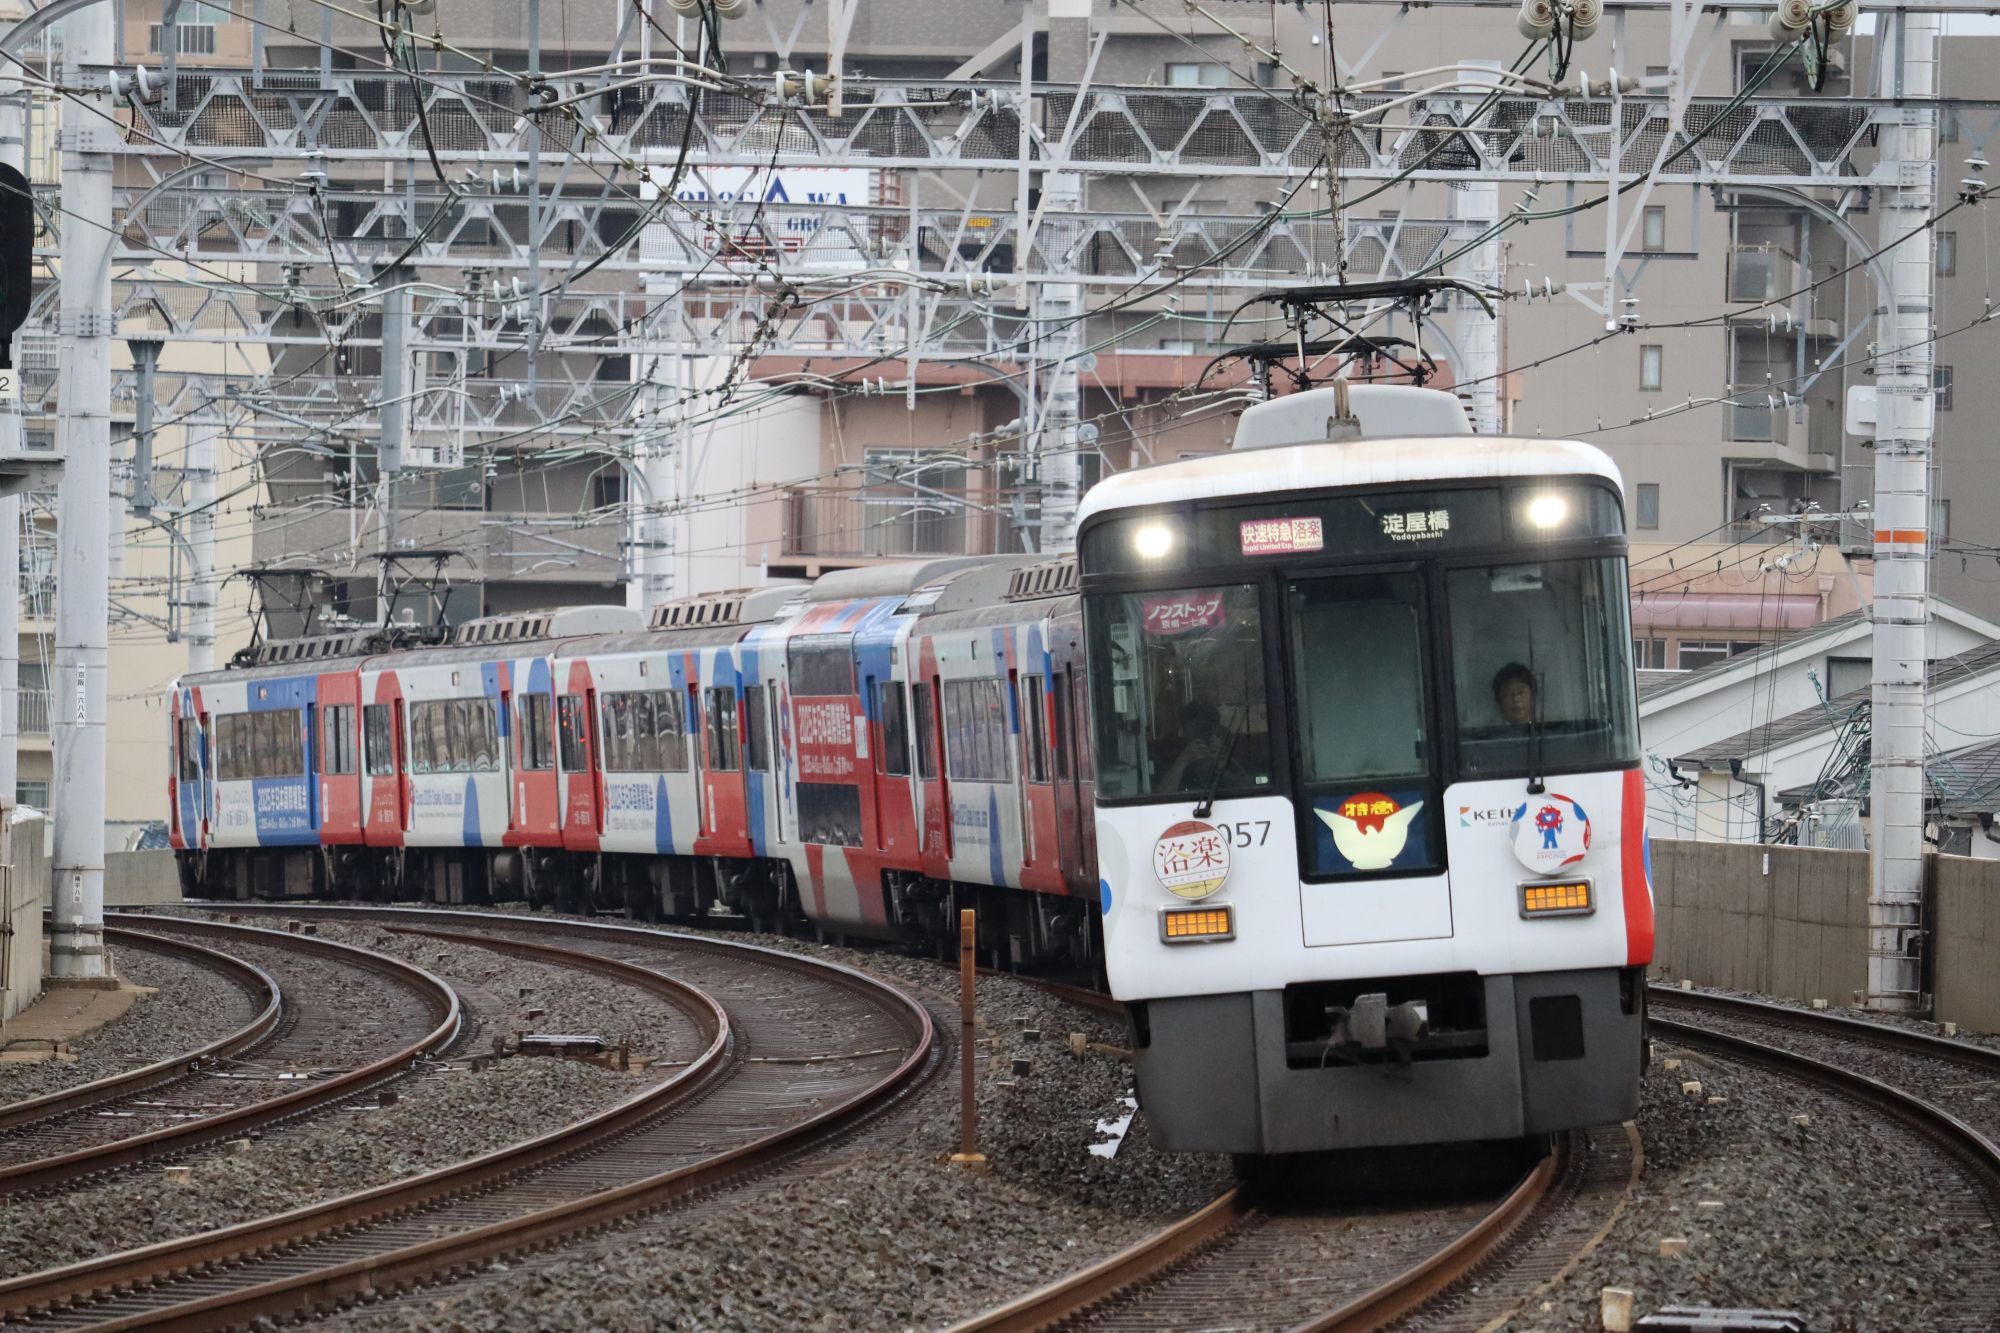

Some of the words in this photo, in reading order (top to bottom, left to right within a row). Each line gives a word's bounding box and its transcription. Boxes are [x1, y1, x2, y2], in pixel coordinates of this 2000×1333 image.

[1241, 521, 1293, 544] 快速特急
[1294, 519, 1322, 540] 洛楽
[1383, 510, 1450, 534] 淀屋橋
[1391, 530, 1443, 541] Yodoyabashi
[1147, 599, 1219, 620] ノンストップ
[1344, 801, 1394, 817] 特急
[1158, 836, 1224, 875] 洛楽
